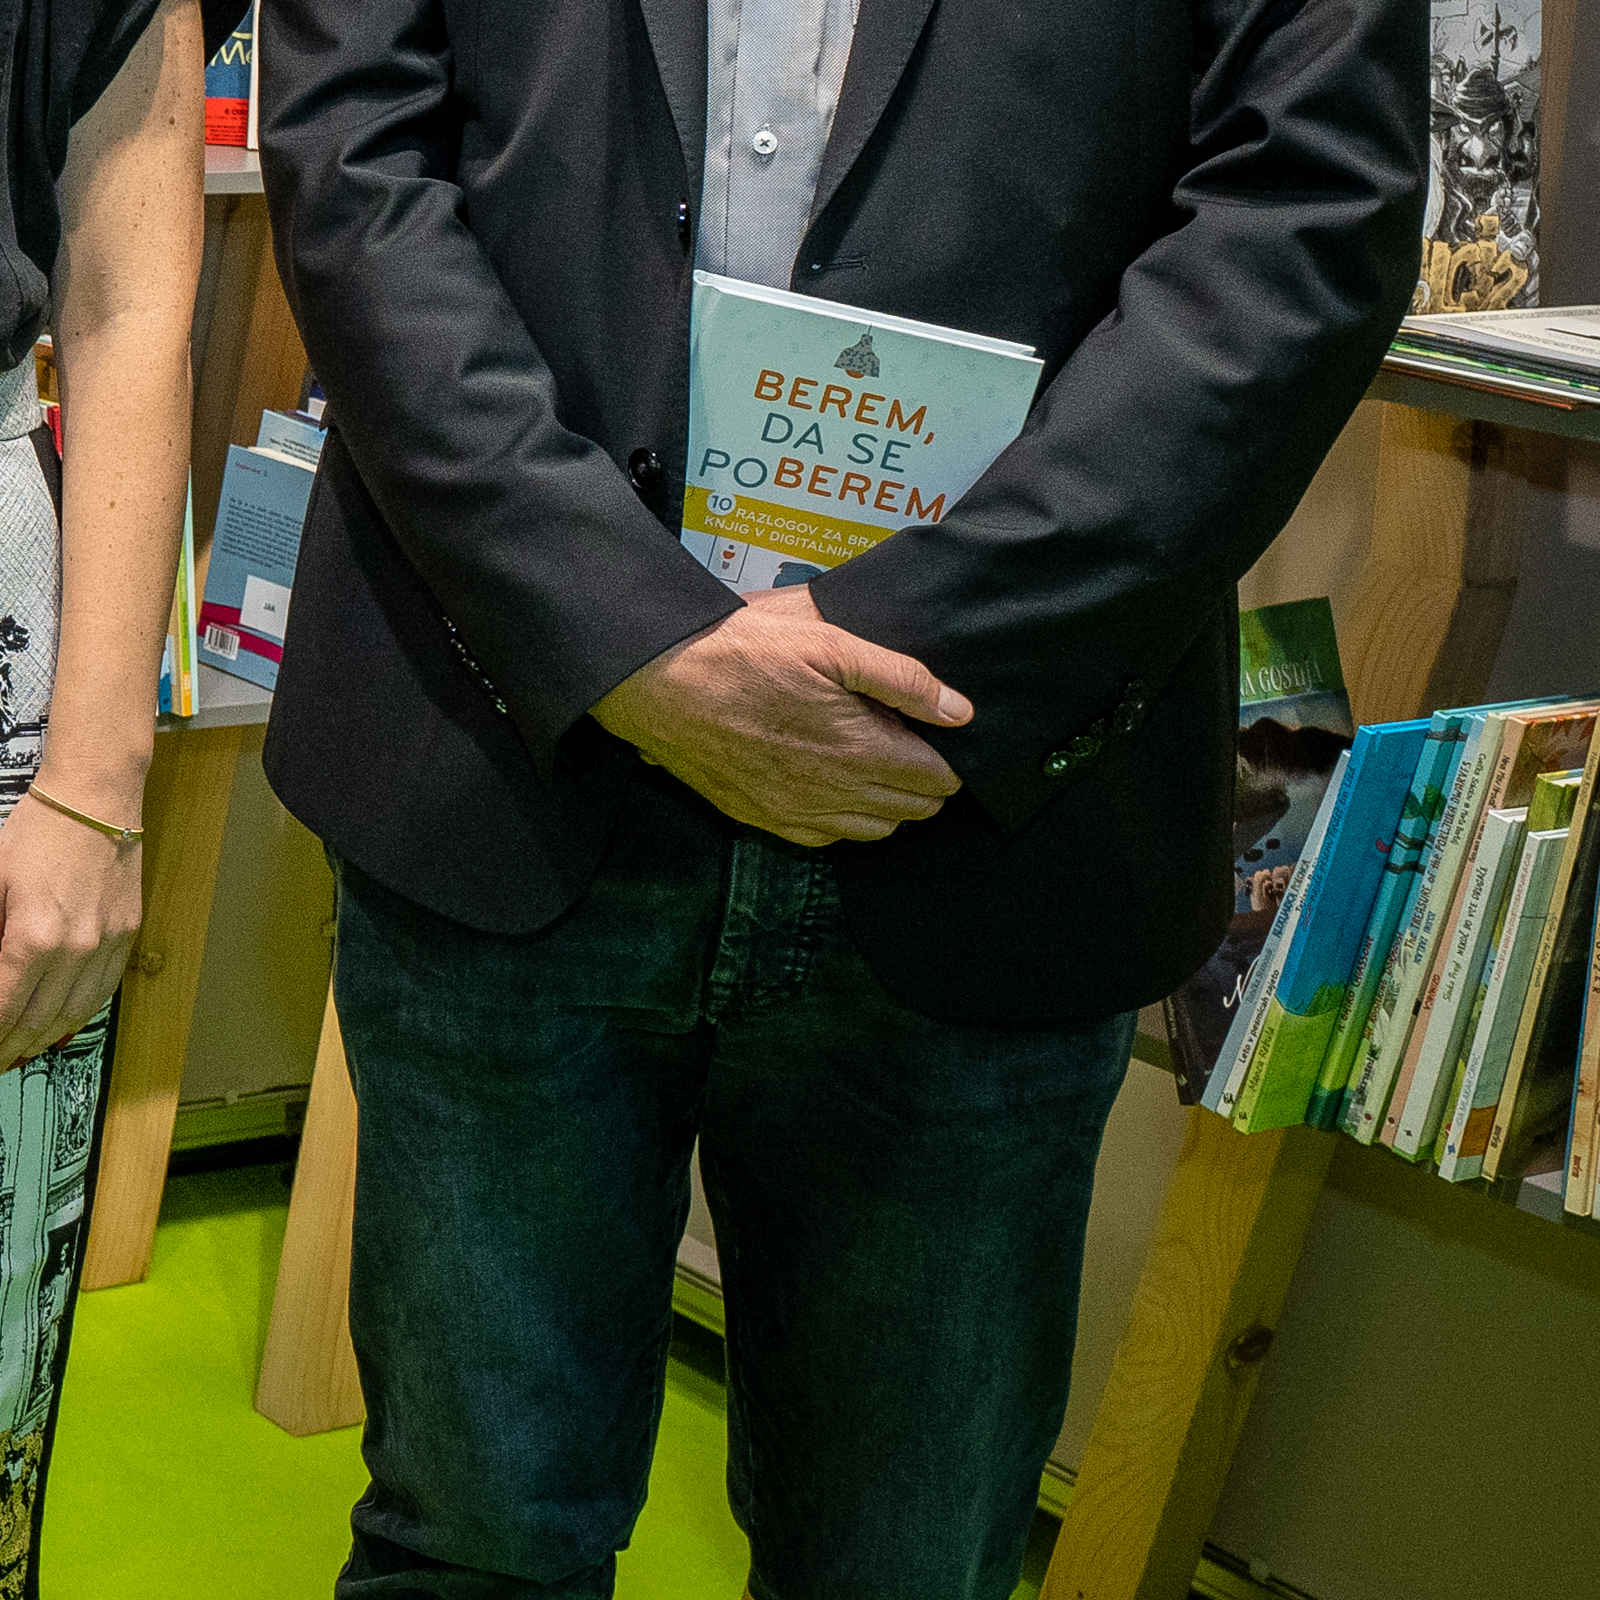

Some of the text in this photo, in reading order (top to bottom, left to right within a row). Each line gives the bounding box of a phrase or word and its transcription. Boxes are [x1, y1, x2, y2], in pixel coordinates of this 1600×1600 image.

[753, 369, 936, 445] BEREM,
[761, 412, 912, 473] DA SE
[699, 447, 947, 524] POBEREM
[704, 516, 854, 559] KNJIG V DIGITALNIH
[712, 494, 733, 512] 10
[735, 506, 819, 536] RAZLOGOV
[823, 528, 843, 542] ZA
[1448, 759, 1473, 804] DWARVES
[1433, 805, 1458, 852] POKLJUKA
[1426, 872, 1437, 884] of
[1429, 853, 1442, 869] the
[1408, 885, 1433, 930] TREASURE
[1403, 931, 1418, 948] The
[1238, 1043, 1251, 1062] Leto
[1247, 995, 1270, 1036] pesmicah
[1262, 967, 1281, 996] zajeto
